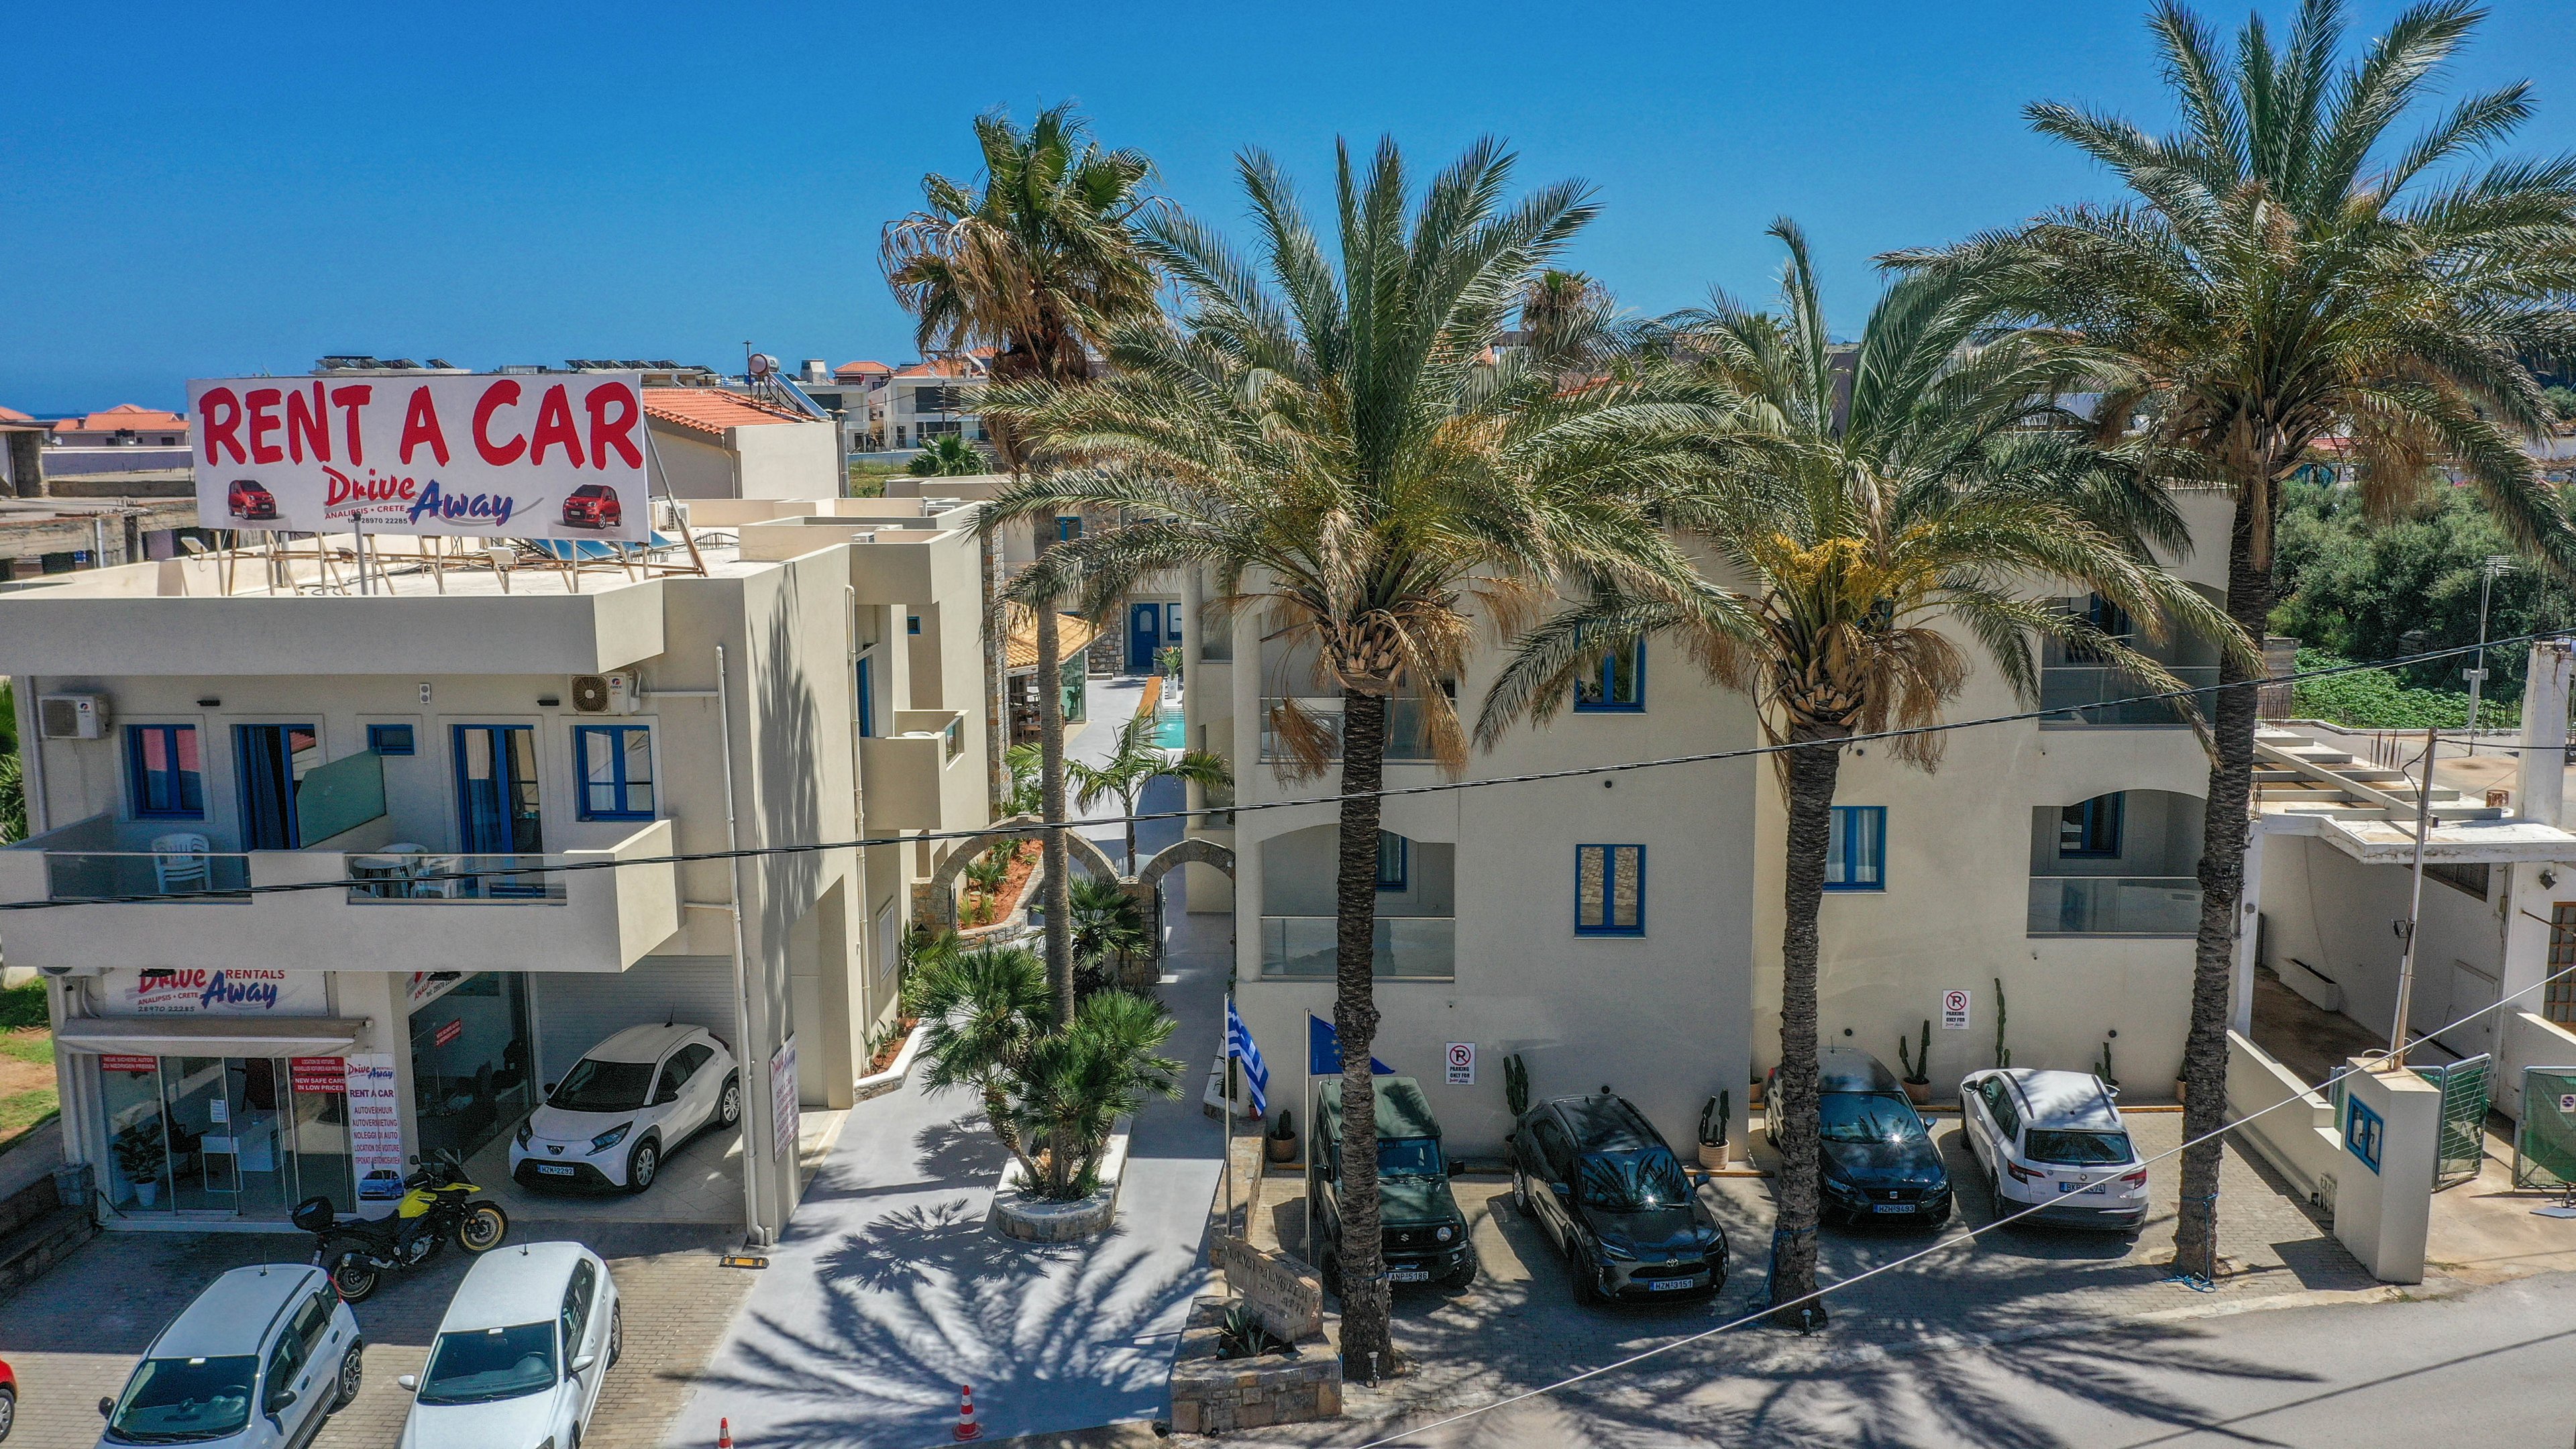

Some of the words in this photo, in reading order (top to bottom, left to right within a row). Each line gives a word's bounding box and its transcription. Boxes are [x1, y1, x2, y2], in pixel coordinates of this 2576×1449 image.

[199, 380, 372, 467] RENT
[399, 385, 449, 468] A
[472, 379, 643, 470] CAR
[322, 465, 416, 506] Drive
[406, 479, 513, 527] Away
[225, 969, 284, 979] RENTALS
[199, 970, 278, 1010] Away
[138, 995, 171, 1006] ANALIPSIS
[347, 1063, 370, 1075] Drive
[368, 1067, 393, 1079] Away
[350, 1089, 369, 1098] RENT
[371, 1089, 376, 1097] A
[378, 1089, 394, 1098] CAR
[354, 1144, 374, 1152] LOCATION
